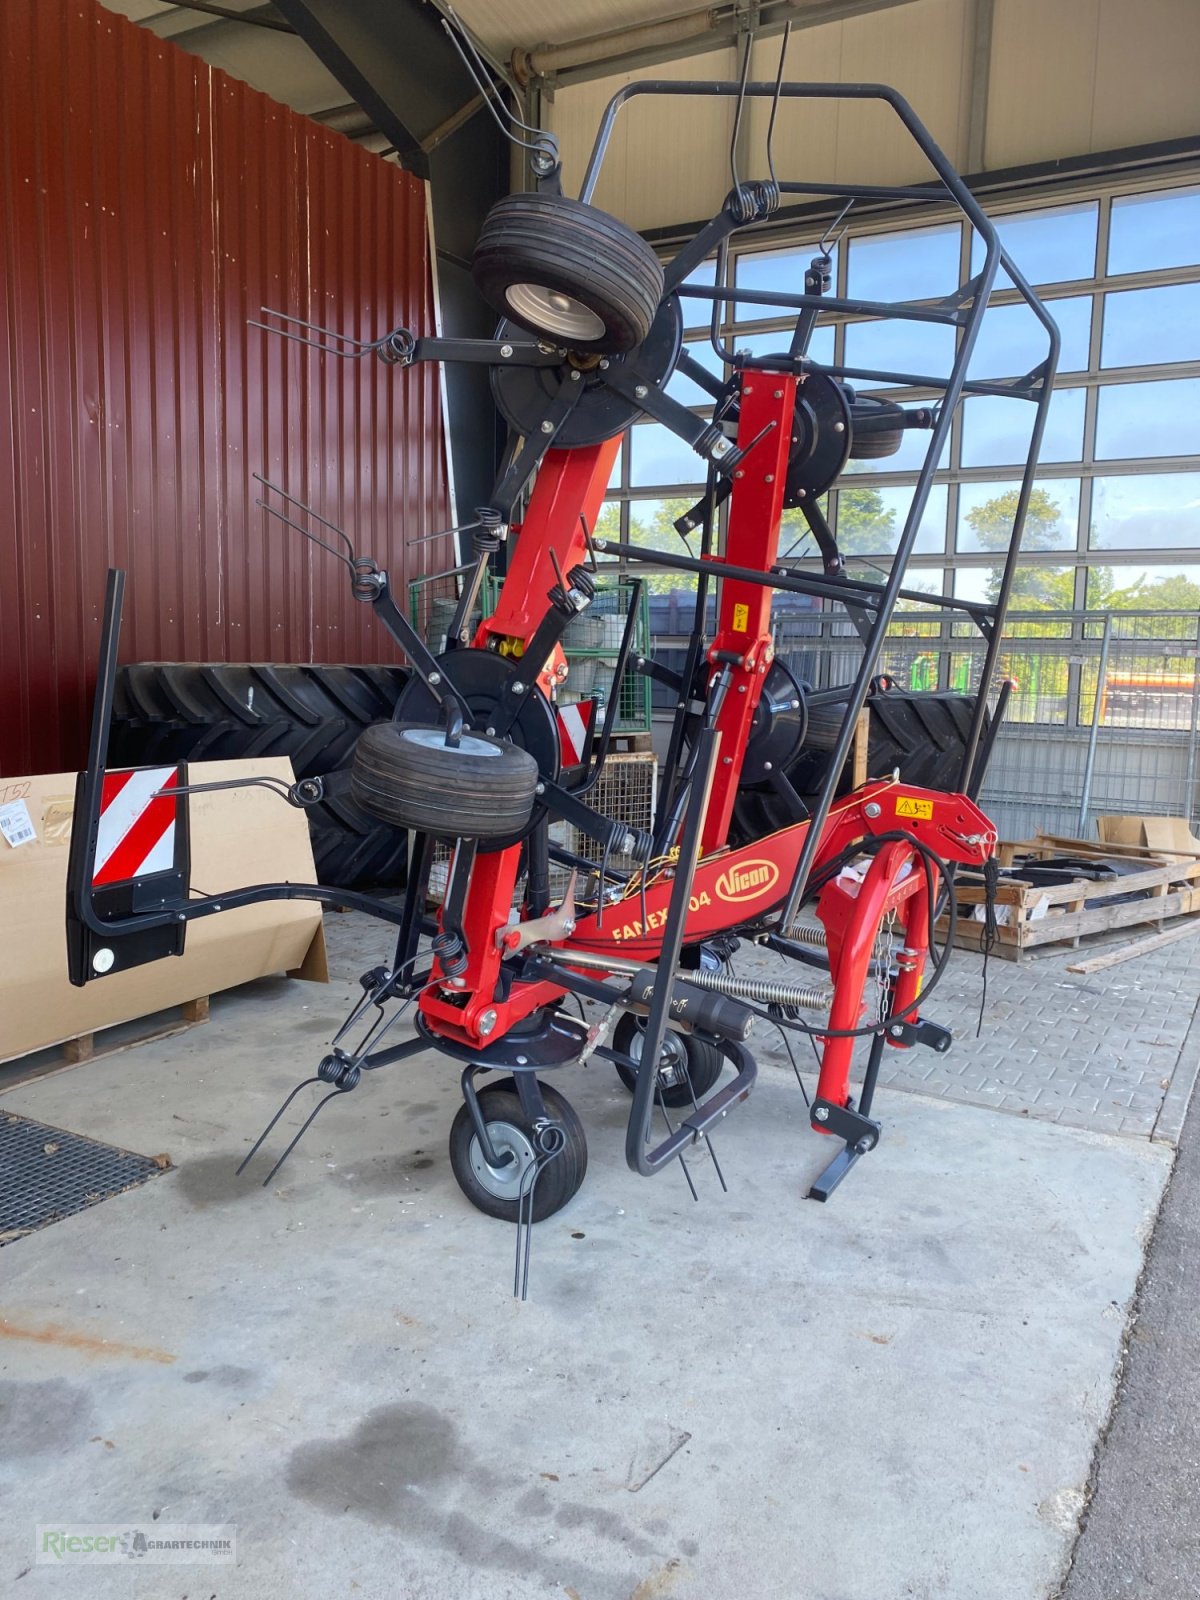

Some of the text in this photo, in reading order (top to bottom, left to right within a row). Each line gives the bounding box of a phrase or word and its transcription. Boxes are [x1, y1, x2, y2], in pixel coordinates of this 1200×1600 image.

[722, 864, 771, 896] Vicon
[612, 891, 712, 944] FANEX 04
